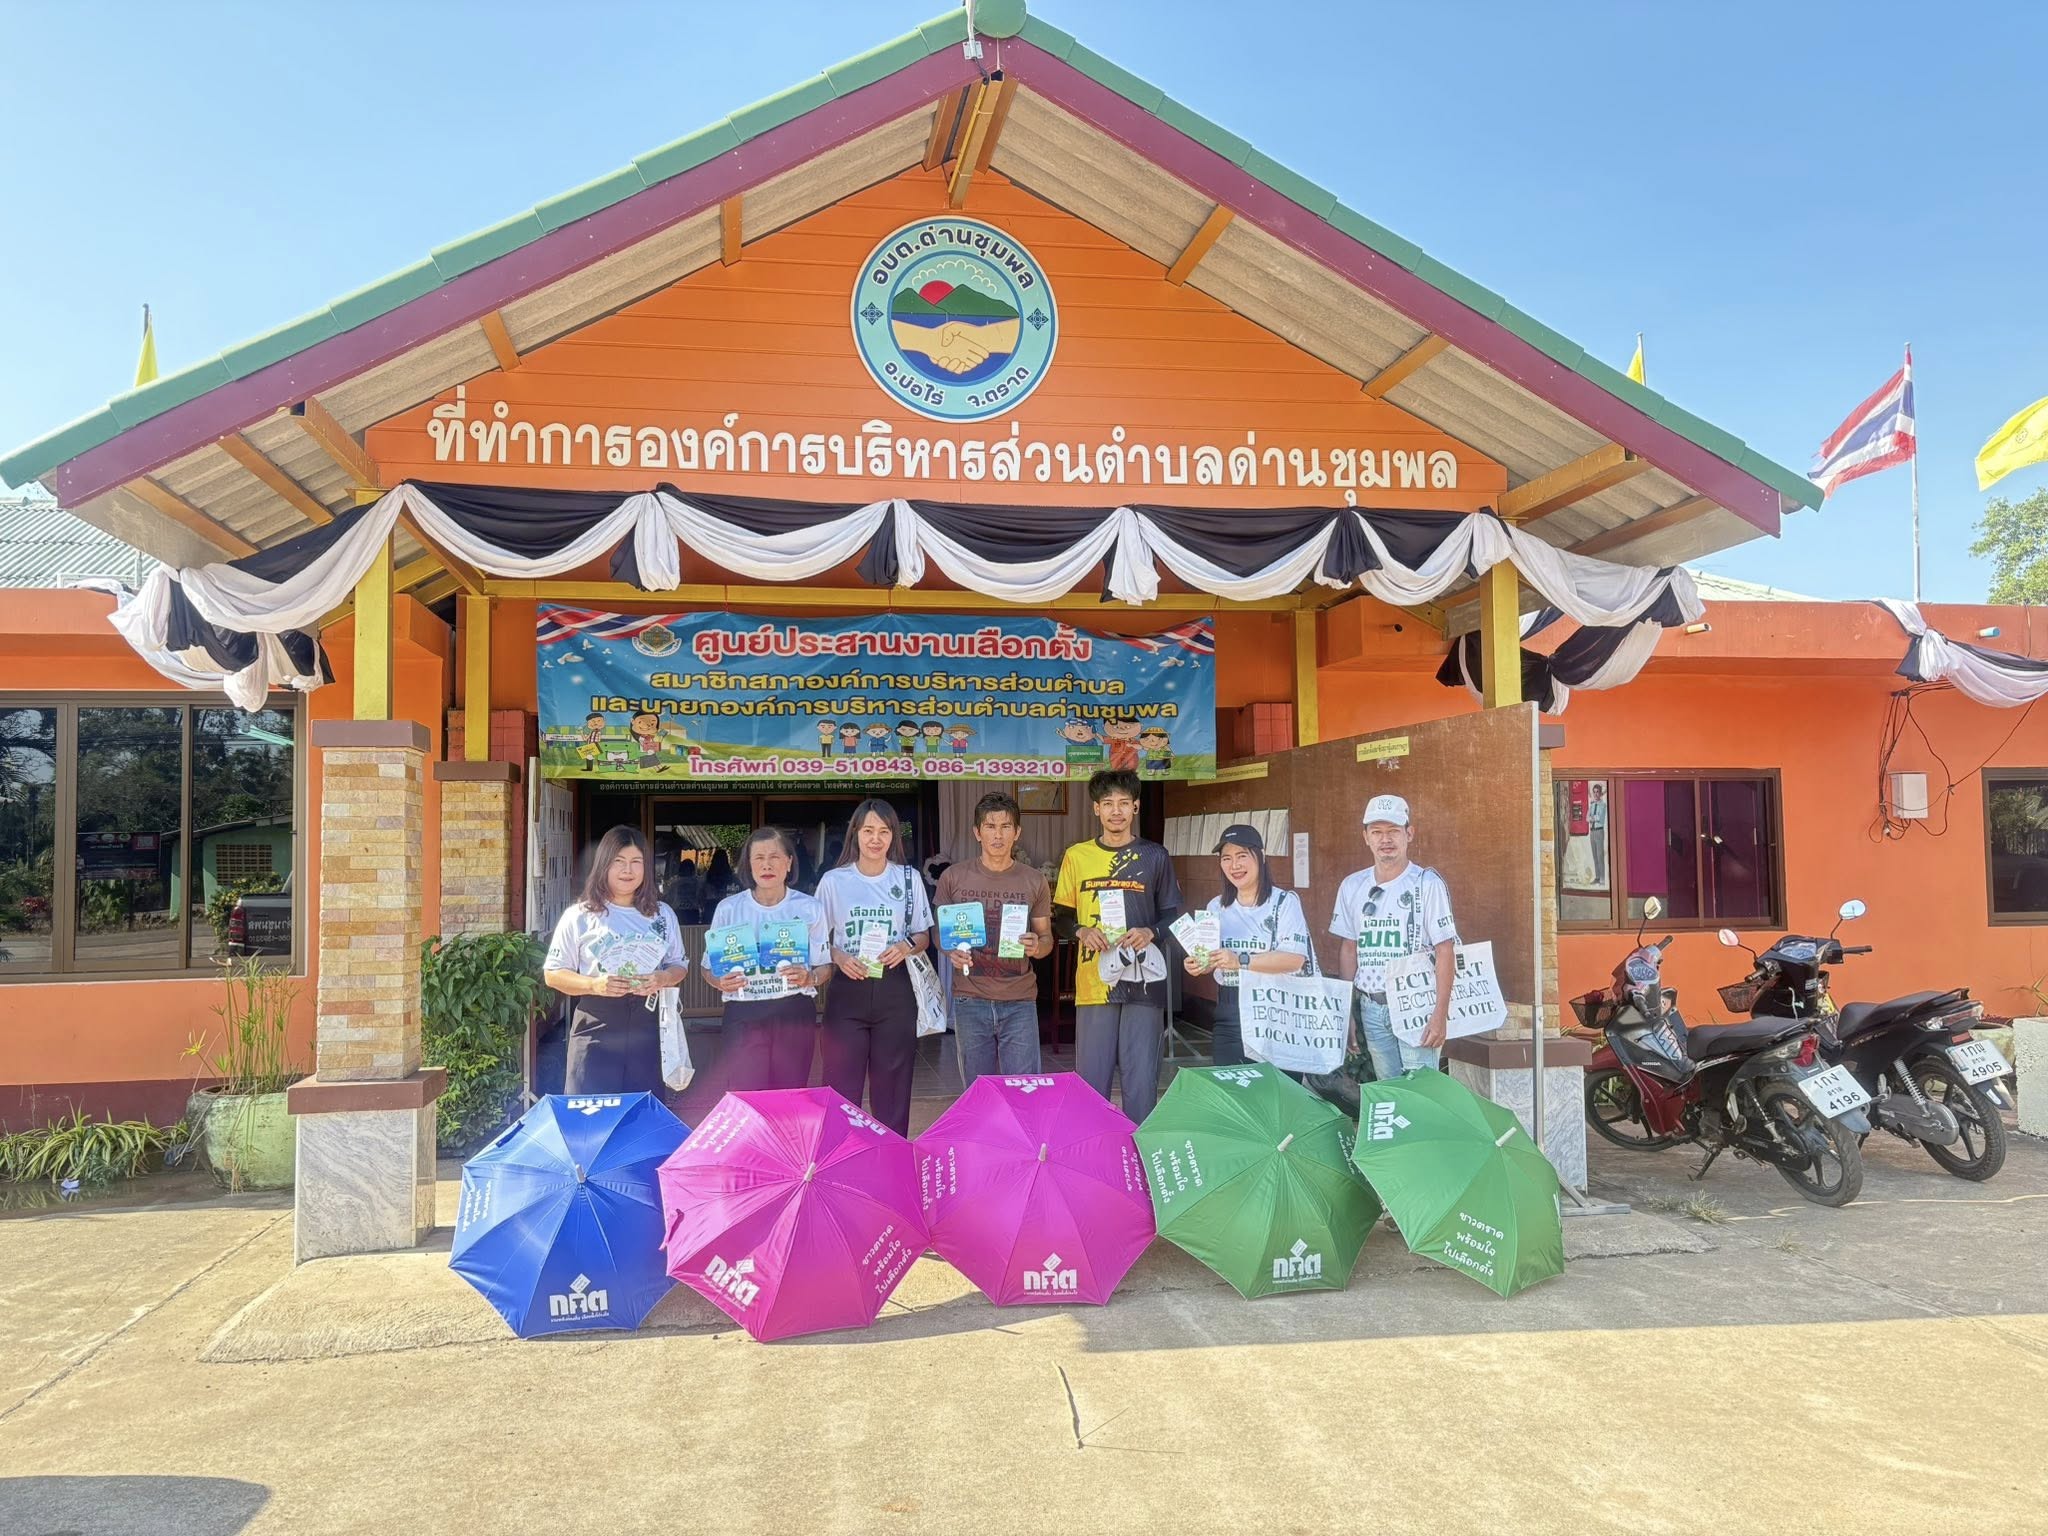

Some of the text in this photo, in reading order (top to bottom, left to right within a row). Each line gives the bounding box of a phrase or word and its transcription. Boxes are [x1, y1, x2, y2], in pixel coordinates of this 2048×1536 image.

[872, 225, 1036, 290] อบต.ด่านชุมพล
[884, 361, 945, 406] อ.บ่อไร่
[967, 365, 1031, 407] จ.ตราด
[426, 384, 1458, 507] ที่ทำการองค์การบริหารส่วนตำบลด่านชุมพล
[694, 622, 1092, 664] ศูนย์ประสานงานเลือกตั้ง
[650, 671, 1125, 695] สมาชิกสภาองค์การบริหารส่วนตำบล
[590, 695, 1178, 724] และนายกองค์การบริหารส่วนตำบลด่านชุมพล
[689, 756, 1066, 776] โทรศัพท์ 039-510843, 086-1393210
[961, 889, 1026, 900] GOLDEN GATE
[1394, 971, 1430, 992] ECT
[1252, 987, 1342, 1011] ECT TRAT
[1397, 990, 1436, 1012] ECT
[1458, 1000, 1497, 1018] VOTE
[1252, 1005, 1344, 1031] ECT TRAT
[1255, 1027, 1300, 1046] LOCAL
[1972, 1061, 2003, 1078] 4905
[1830, 1092, 1861, 1110] 4196
[1169, 1150, 1188, 1191] พร้อมใจ
[1185, 1140, 1203, 1187] ชาวตราด
[1459, 1212, 1504, 1240] ชาวตราด
[862, 1225, 894, 1265] ชาวตราด
[874, 1240, 901, 1276] พร้อมใจ
[1443, 1240, 1494, 1277] ไปเลือกตั้ง
[1456, 1232, 1496, 1257] พร้อมใจ
[875, 1248, 912, 1294] ไปเลือกตั้ง
